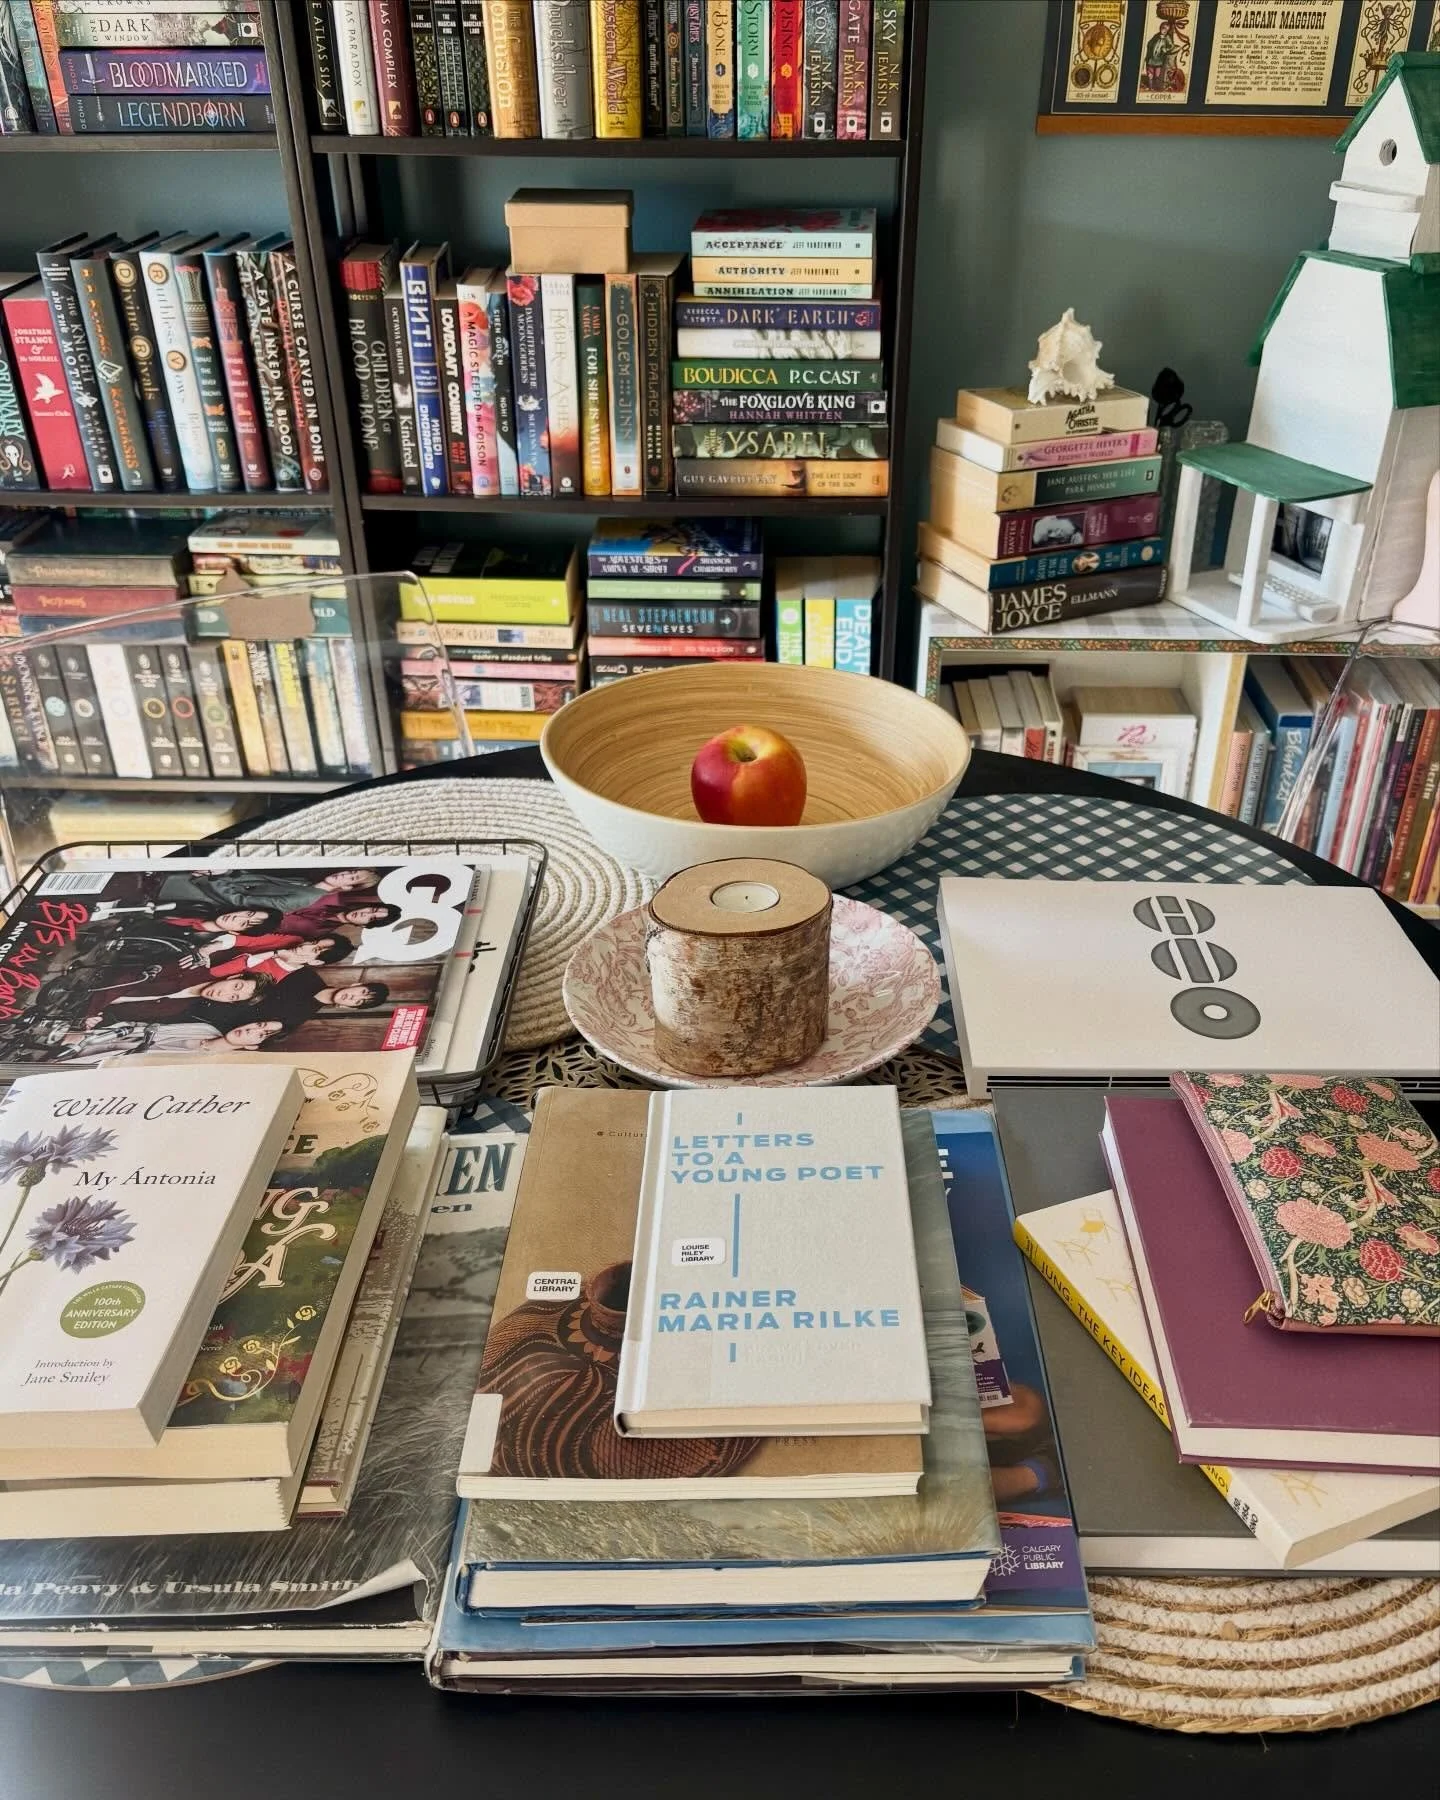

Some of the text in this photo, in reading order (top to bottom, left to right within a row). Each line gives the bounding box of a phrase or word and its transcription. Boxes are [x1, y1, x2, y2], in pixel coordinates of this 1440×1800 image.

[99, 18, 152, 33] DARK
[745, 0, 762, 57] STORM
[883, 9, 897, 45] SKY
[1230, 10, 1327, 29] 22 ARCANI MAGGIORI
[104, 34, 150, 42] WINDOW
[711, 11, 729, 57] BONE
[313, 16, 333, 88] ATLAS SIX
[348, 29, 363, 87] PARADOX
[382, 29, 399, 88] COMPLEX
[108, 61, 248, 89] BLOODMARKED
[809, 50, 822, 106] JEMISIN
[842, 49, 855, 106] JEMISIN
[877, 51, 889, 106] JEMISIN
[117, 98, 246, 128] LEGENDBORN
[706, 240, 784, 250] ACCEPTANCE
[718, 267, 786, 275] AUTHORITY
[706, 287, 794, 295] ANNIHILATION
[727, 309, 848, 325] DARK EARTH
[14, 328, 52, 336] JONATHAN
[15, 336, 53, 344] STRANGE
[113, 259, 142, 333] Divine
[131, 335, 161, 401] Rivals
[467, 321, 478, 358] MAGIC
[71, 323, 96, 384] KNIGHT
[254, 270, 293, 456] A FATE INKED IN BLOOD
[284, 262, 325, 463] A CURSE CARVED IN BONE
[586, 347, 598, 375] FOR
[647, 302, 659, 417] HIDDEN PALACE
[62, 340, 84, 397] MOTH
[370, 340, 394, 420] CHILDREN
[440, 308, 463, 435] LOVECRAFT COUNTRY
[617, 313, 633, 440] GOLEM JINN
[684, 367, 861, 385] BOUDICCA CAST
[349, 318, 379, 451] BLOOD BONE
[470, 361, 484, 411] STEEPED
[588, 379, 599, 401] SHE
[720, 393, 856, 411] THE FOXGLOVE KING
[729, 411, 842, 420] HANNAH WHITTEN
[1066, 405, 1095, 425] AGATHA
[1068, 418, 1099, 430] CHRISTIE
[399, 415, 418, 468] Kindred
[476, 426, 487, 467] POISON
[727, 431, 829, 455] YSABEL
[998, 584, 1068, 613] JAMES
[1071, 588, 1120, 605] ELLMANN
[603, 608, 715, 624] NEAL STEPHENSON
[997, 603, 1063, 631] JOYCE
[622, 624, 694, 634] SEVENEVES
[836, 617, 853, 664] END
[1276, 729, 1304, 802] Blankets
[1423, 762, 1439, 800] Berlin
[53, 1095, 251, 1121] Willa Cather
[673, 1132, 815, 1151] LETTERS
[672, 1151, 745, 1167] TO A
[74, 1167, 217, 1191] My Ántonia
[671, 1165, 885, 1185] YOUNG POET
[681, 1244, 710, 1252] LOUISE
[681, 1255, 715, 1263] LIBRARY
[535, 1278, 578, 1286] CENTRAL
[94, 1298, 121, 1306] 100th
[659, 1289, 798, 1311] RAINER
[64, 1309, 138, 1318] ANNIVERSARY
[74, 1320, 118, 1329] EDITION
[657, 1309, 901, 1334] MARIA RILKE
[1041, 1260, 1167, 1418] JUNG: THE KEY IDEAS
[35, 1358, 117, 1369] Introduction by
[22, 1371, 110, 1387] Jane Smiley
[1022, 1544, 1062, 1553] CALGARY
[1023, 1553, 1056, 1561] PUBLIC
[1024, 1561, 1064, 1570] LIBRARY
[33, 1579, 360, 1599] Peavy & Ursula Smith
